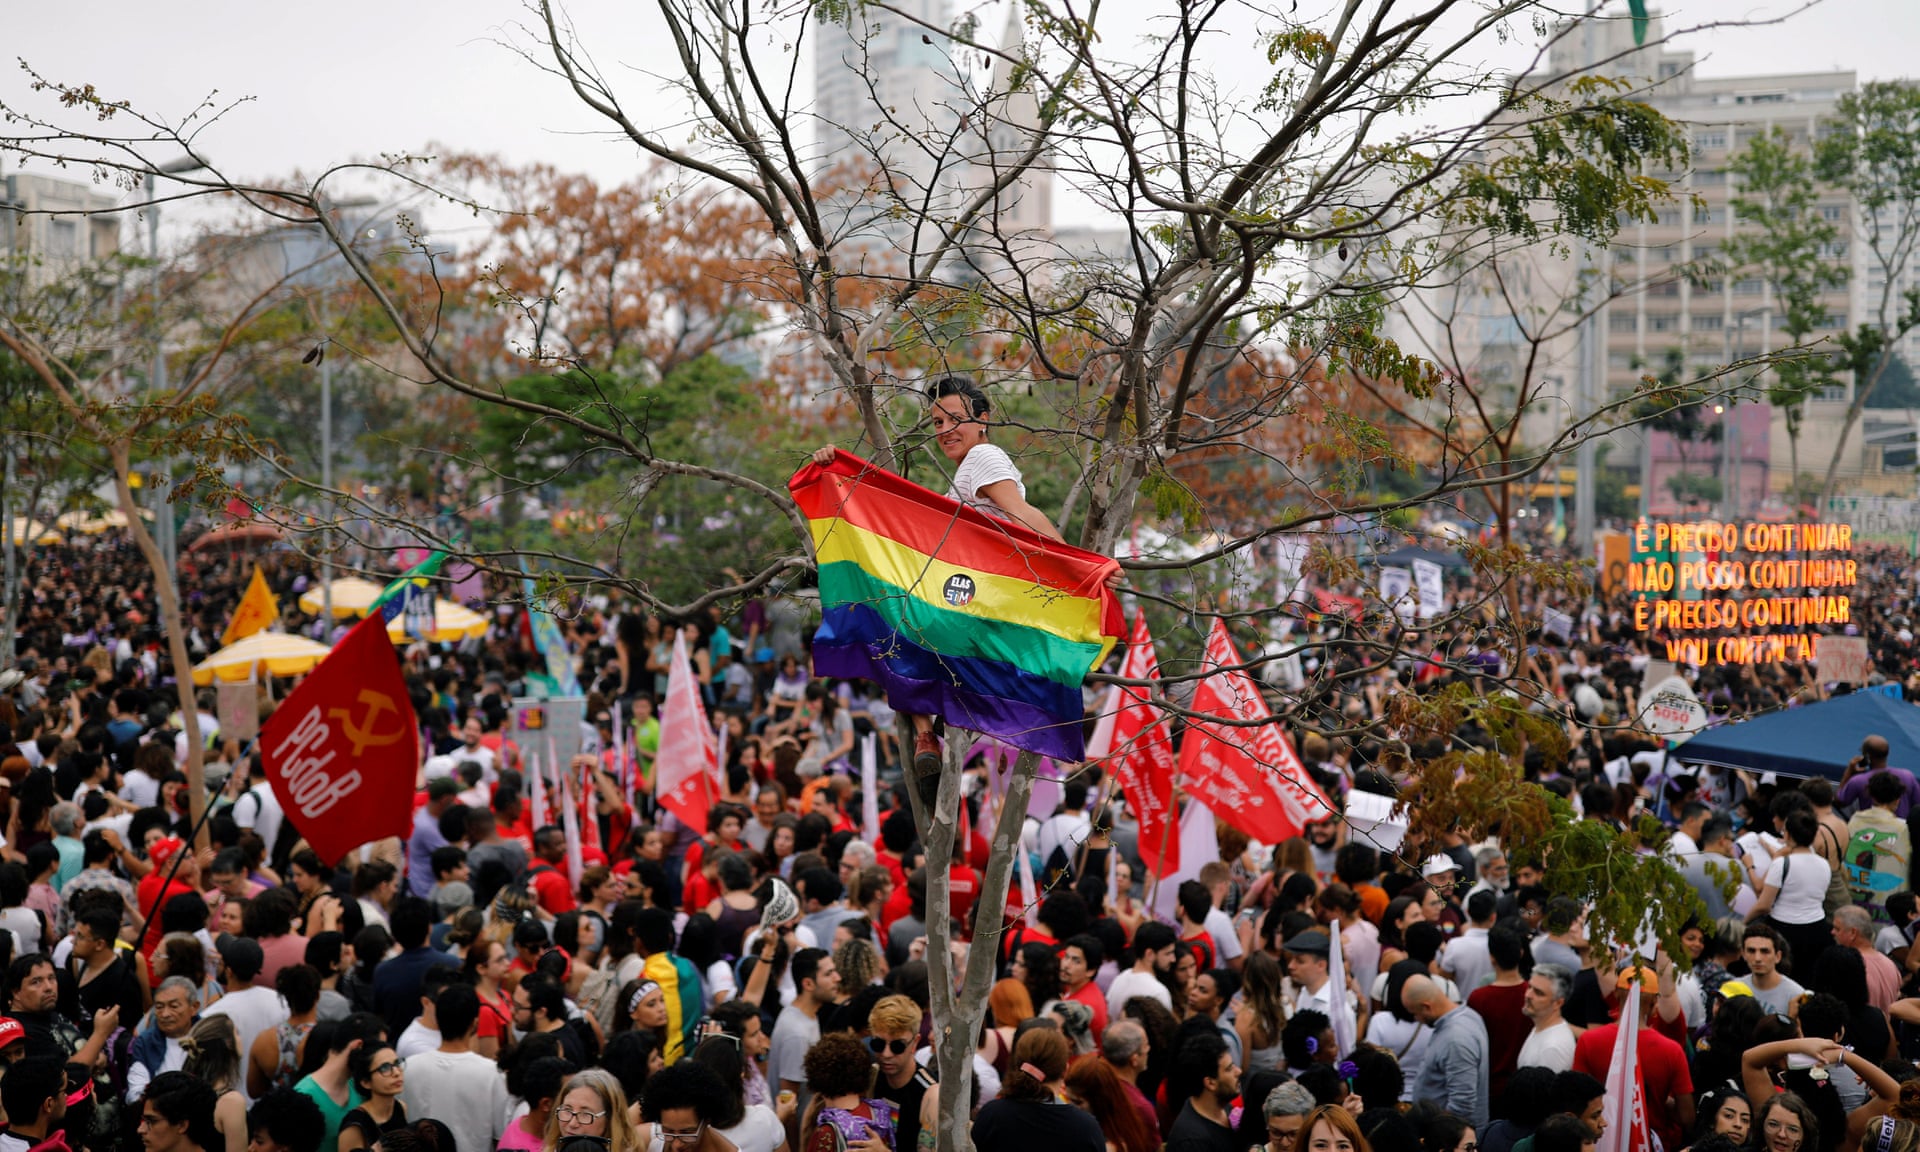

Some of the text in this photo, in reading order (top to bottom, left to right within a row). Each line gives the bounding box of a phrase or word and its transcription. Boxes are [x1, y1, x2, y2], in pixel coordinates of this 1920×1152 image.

[1635, 516, 1851, 553] É PRECISO CONTINUAR
[951, 576, 971, 589] ELAS
[1628, 557, 1857, 592] NÃO POSSO CONTINUAR
[1635, 593, 1850, 631] É PRECISO CONTINUAR
[1665, 637, 1709, 666] VOU
[271, 704, 362, 818] PCdoB
